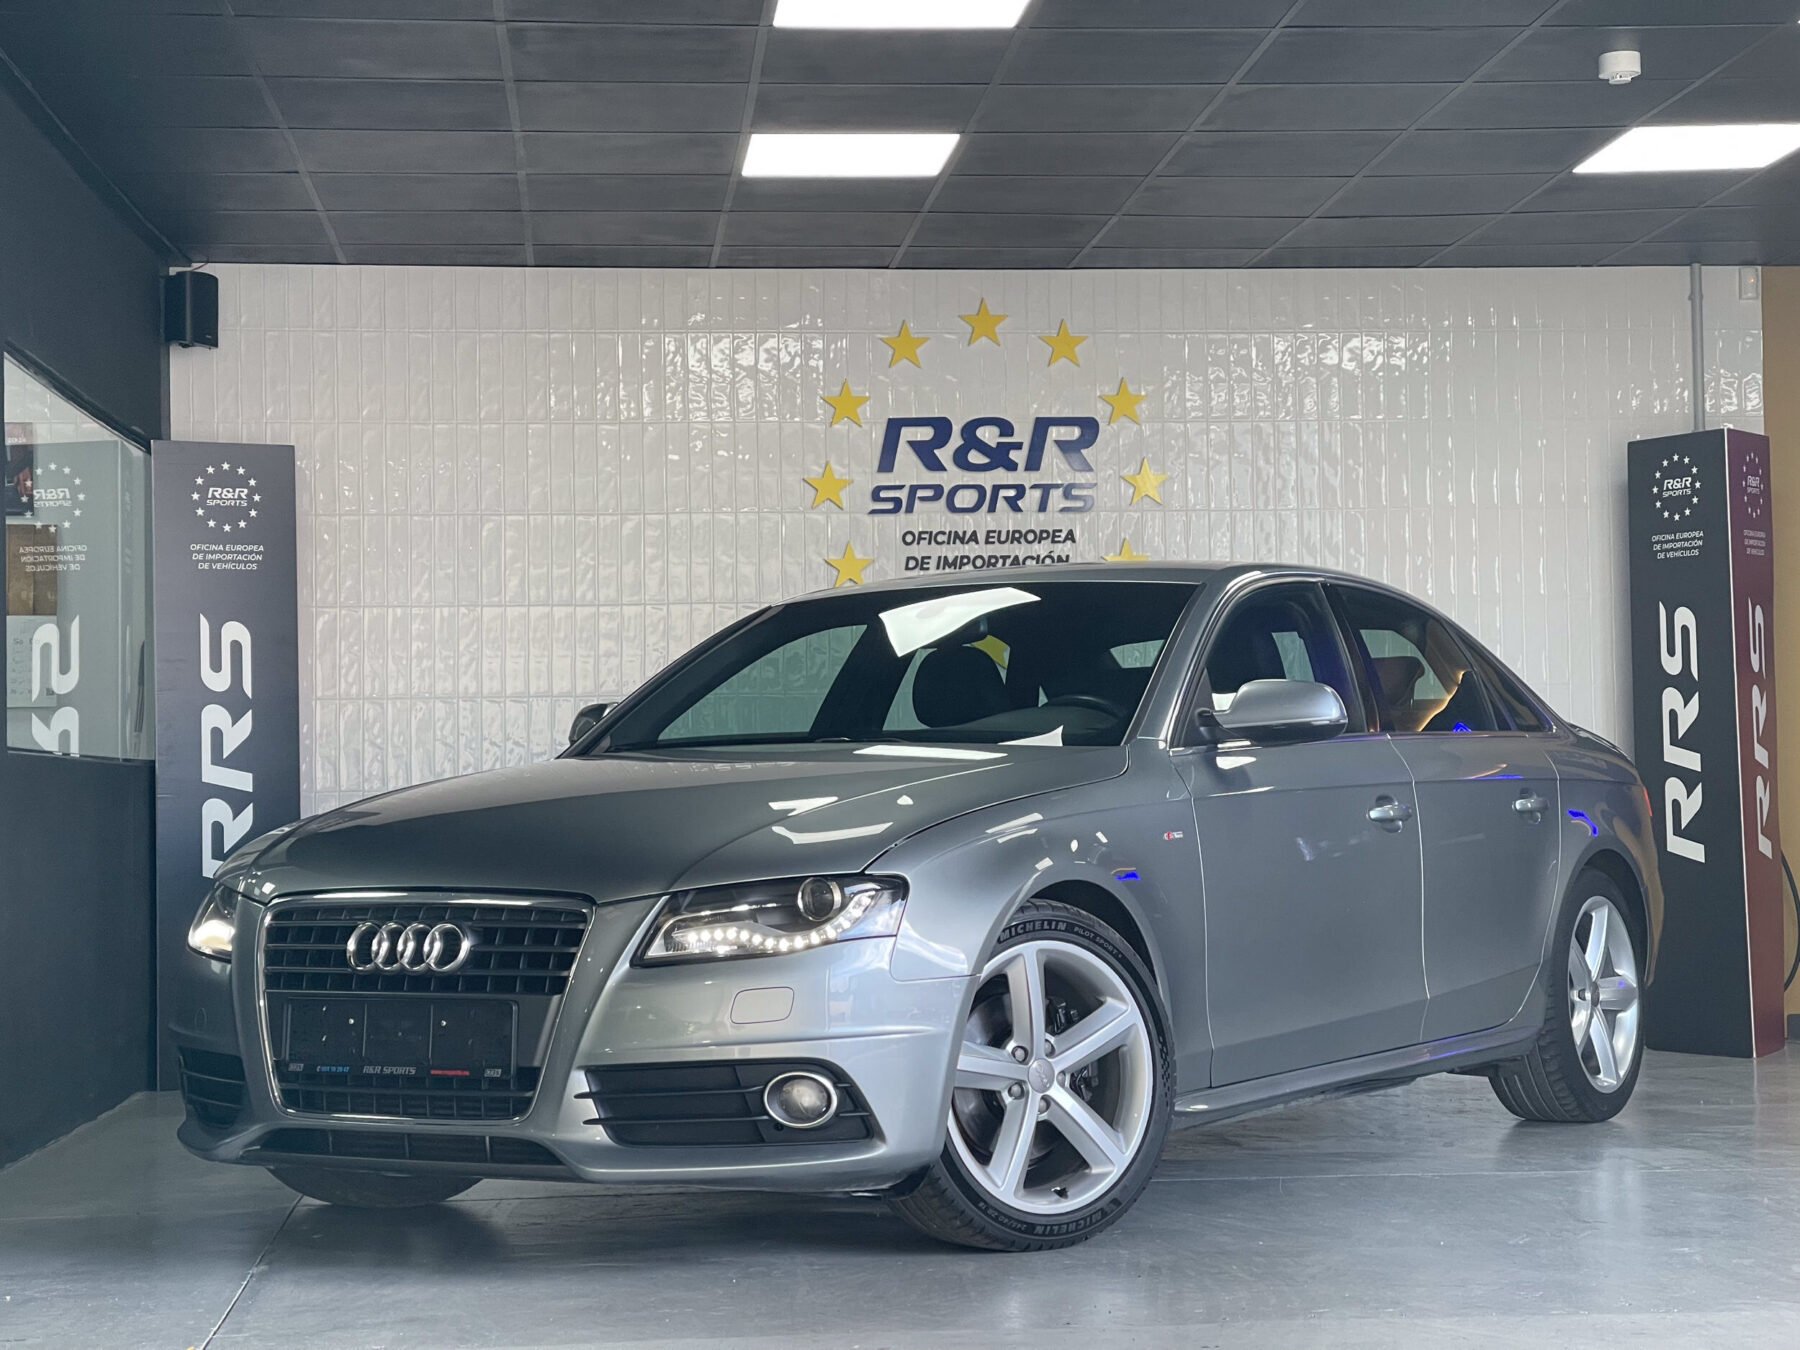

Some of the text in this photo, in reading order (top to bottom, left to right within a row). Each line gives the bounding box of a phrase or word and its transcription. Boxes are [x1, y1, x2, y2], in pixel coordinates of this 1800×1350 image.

[877, 416, 1100, 472] R&R
[1663, 476, 1692, 491] R&R
[207, 487, 249, 500] R&R
[868, 483, 1098, 515] SPORTS
[1662, 488, 1692, 498] SPORTS
[206, 499, 248, 507] SPORTS
[901, 528, 1077, 546] OFICINA EUROPEA
[1651, 530, 1704, 542] OFICINA EUROPEA
[190, 543, 264, 552] OFICINA EUROPEA
[1653, 539, 1703, 551] DE IMPORTACIÓN
[205, 552, 263, 561] IMPORTACIÓN
[1657, 551, 1666, 560] DE
[198, 561, 258, 570] DE VEHÍCULOS
[904, 555, 932, 571] DE
[1659, 600, 1706, 864] RRS
[1748, 596, 1773, 861] RRS
[200, 612, 254, 879] RRS
[1000, 920, 1118, 955] MICHELIN PILOT SPORT
[363, 1065, 417, 1075] R&R SPORTS
[1033, 1210, 1104, 1236] MICHELIN
